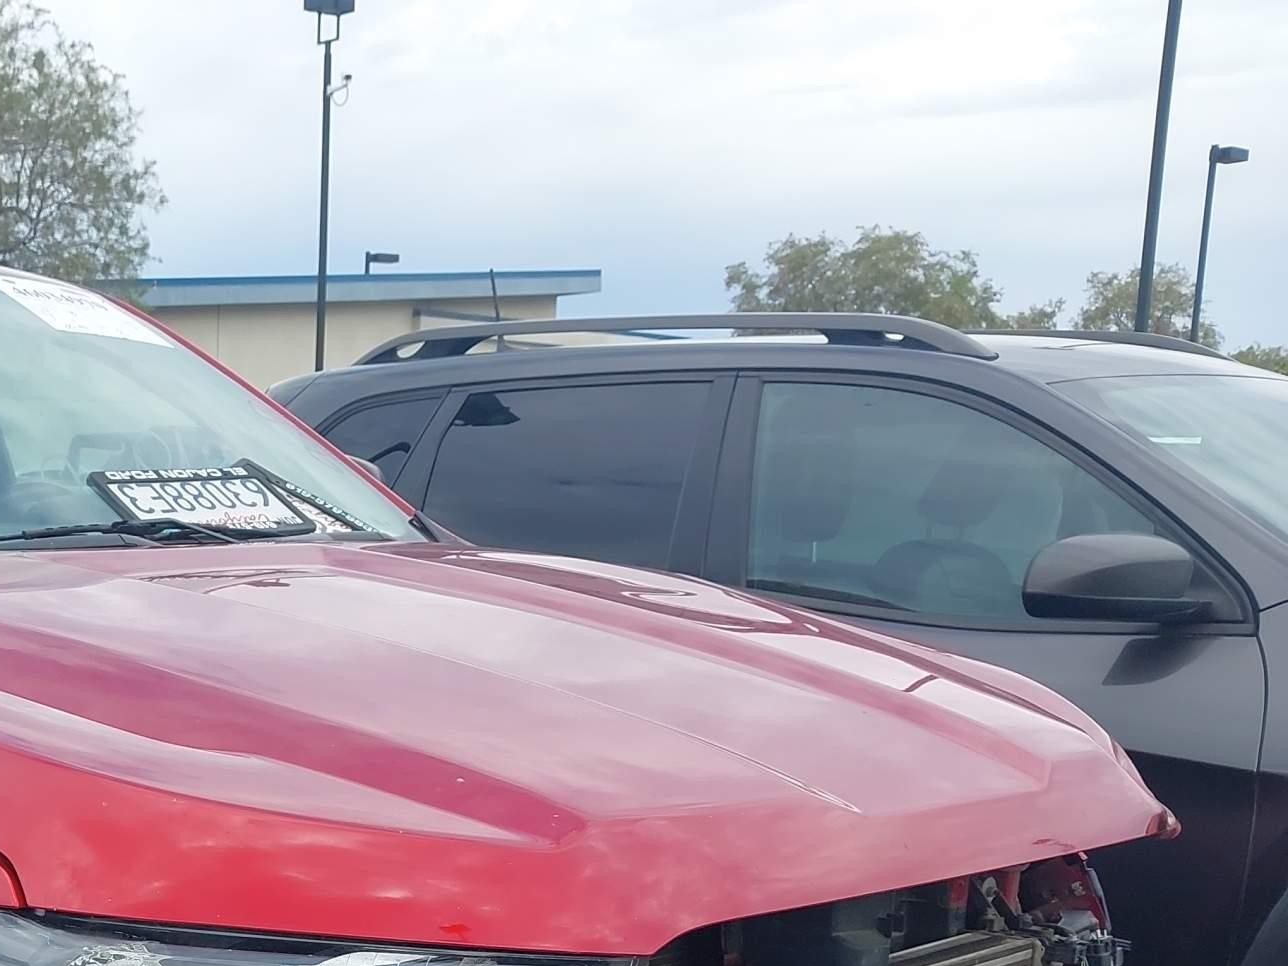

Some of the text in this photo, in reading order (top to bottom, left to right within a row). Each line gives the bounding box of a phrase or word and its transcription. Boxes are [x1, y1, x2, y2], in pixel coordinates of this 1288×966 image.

[105, 467, 249, 480] EL CAJON FORD
[117, 478, 270, 514] 63088E3
[285, 483, 380, 533] 619-579-888
